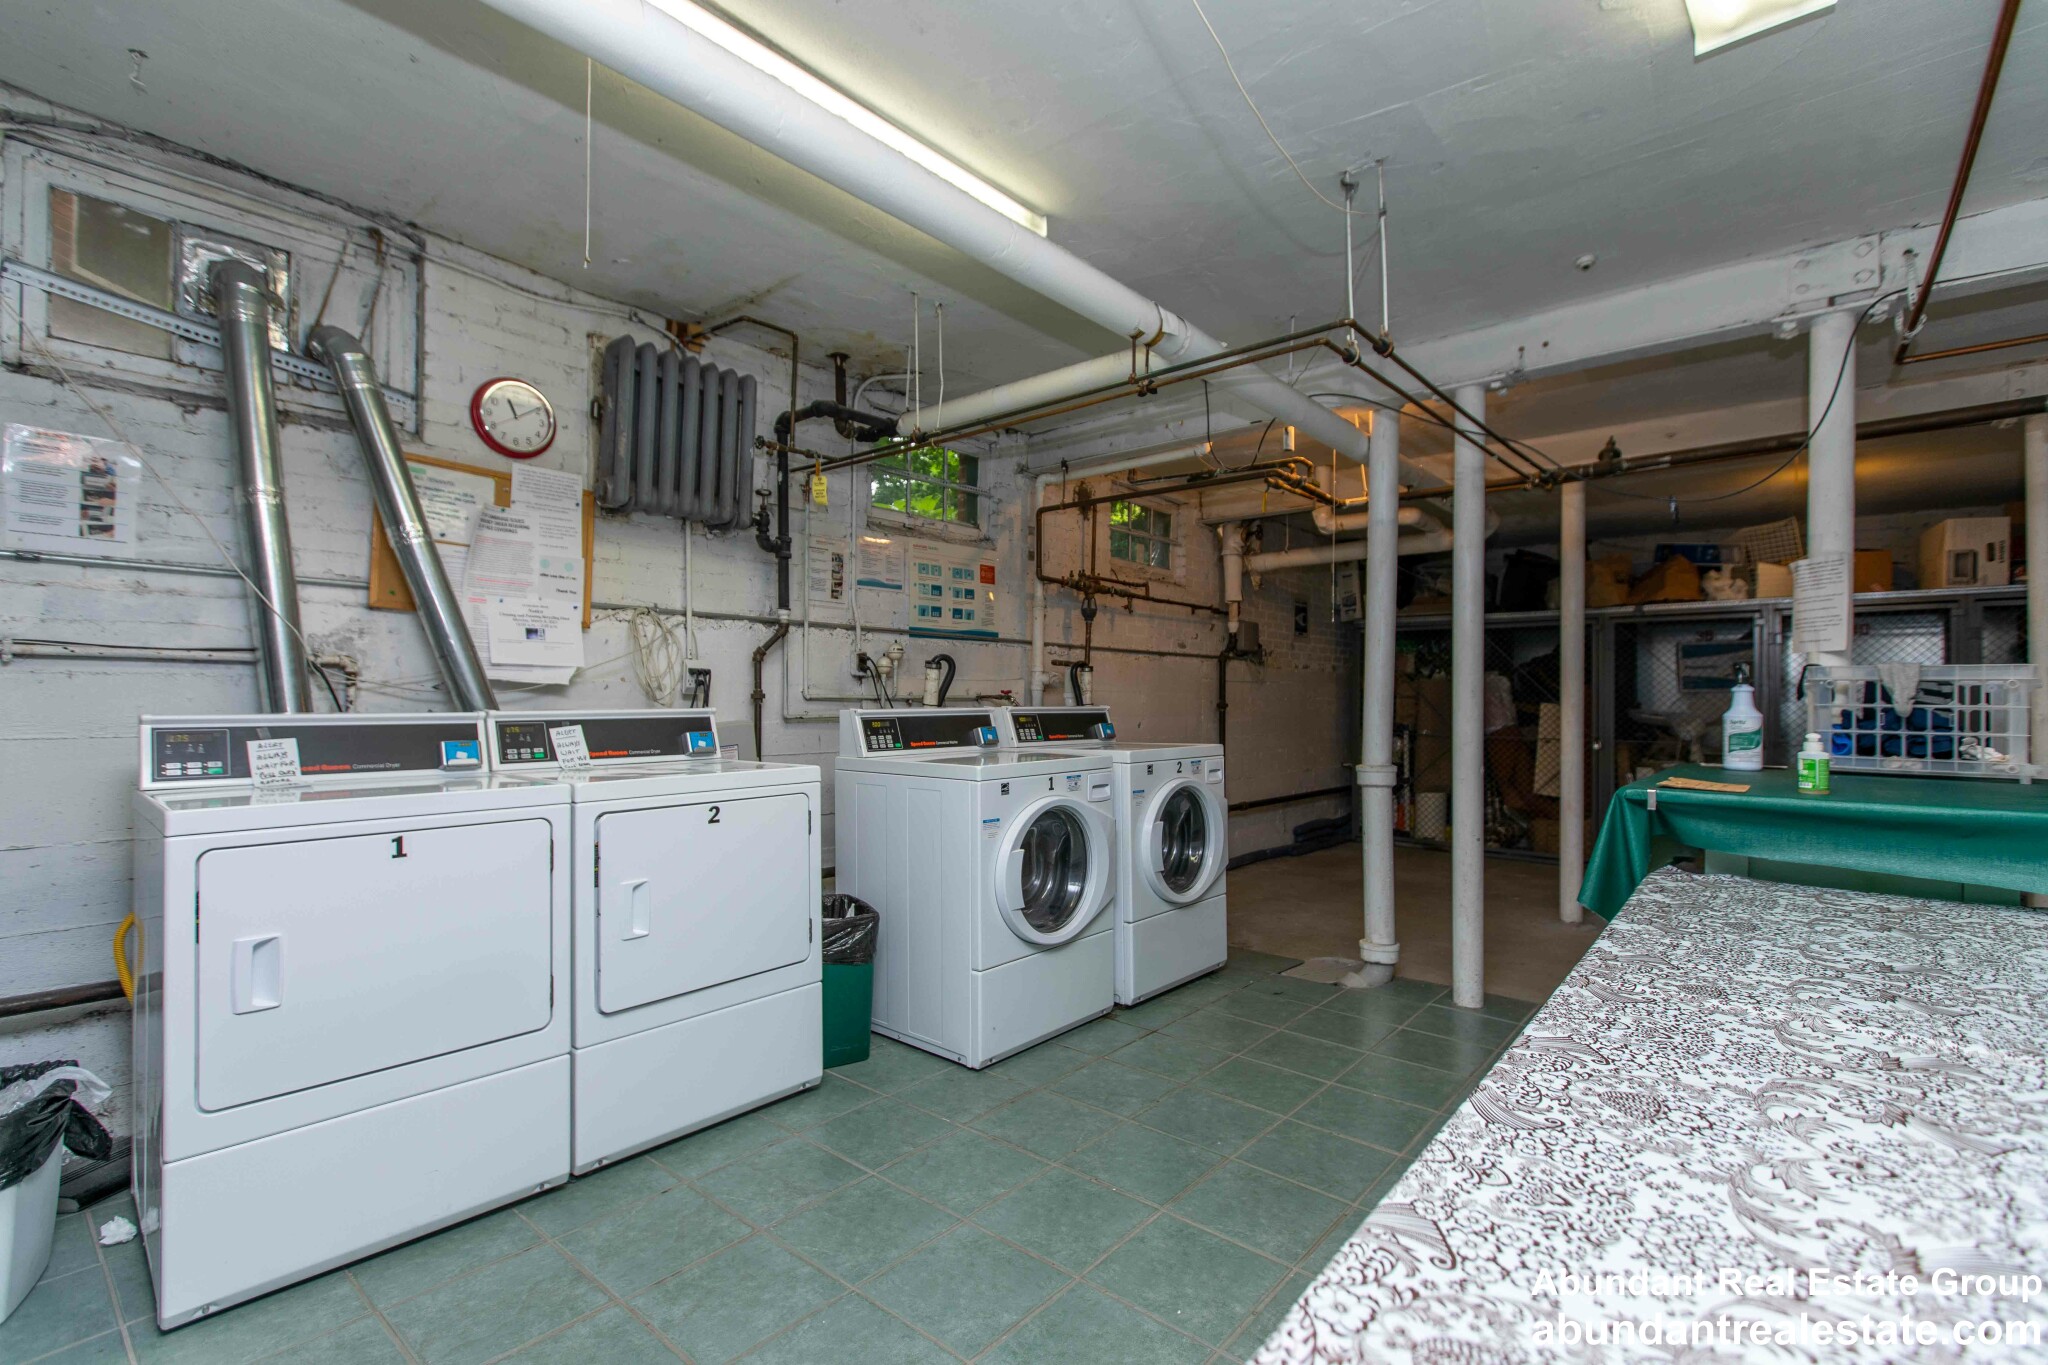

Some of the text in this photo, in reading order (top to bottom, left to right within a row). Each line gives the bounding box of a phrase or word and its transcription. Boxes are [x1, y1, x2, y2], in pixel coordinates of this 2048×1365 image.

[539, 419, 544, 427] 3
[1177, 761, 1182, 773] 2
[1048, 777, 1054, 790] 1
[708, 806, 720, 824] 2
[392, 836, 407, 858] 1
